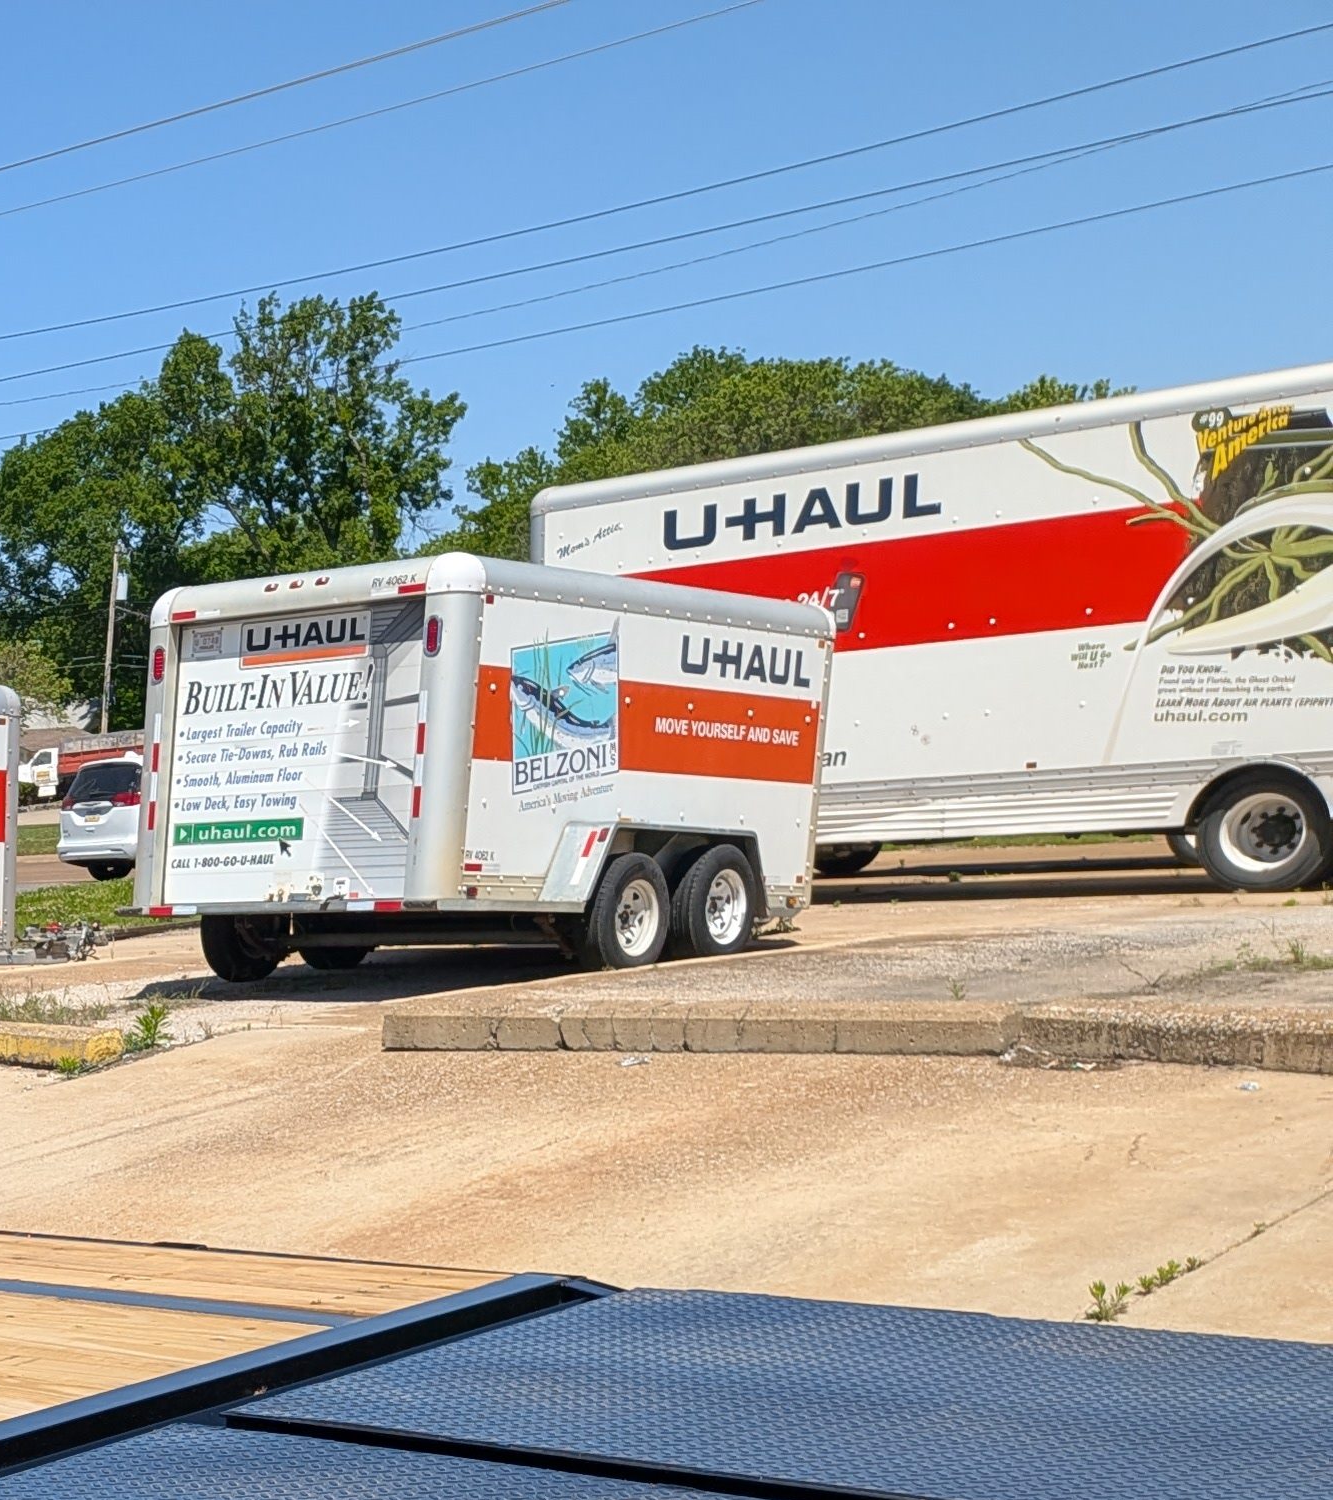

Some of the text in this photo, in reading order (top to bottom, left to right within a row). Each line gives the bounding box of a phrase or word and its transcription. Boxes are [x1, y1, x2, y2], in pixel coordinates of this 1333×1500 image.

[1196, 411, 1257, 454] Venture
[1211, 413, 1289, 481] America
[663, 472, 942, 551] U-HAUL
[556, 536, 590, 560] Mom's
[371, 573, 418, 588] RV 4062 K
[246, 616, 365, 652] U-HAUL
[681, 634, 811, 689] U-HAUL
[182, 663, 375, 715] BUILT-IN VALUE!
[1153, 710, 1248, 722] uhaul.com
[186, 720, 303, 743] Largest Trailer Capacity
[655, 717, 800, 747] MOVE YOURSELF AND SAVE
[185, 740, 328, 765] Secure Tie-Downs, Rub Rails
[514, 743, 607, 786] BELZONI
[183, 769, 303, 788] Smooth, Aluminum Floor
[181, 793, 298, 812] Low Deck, Easy Towing
[553, 789, 579, 805] Moving
[198, 822, 296, 840] uhaul.com
[171, 857, 190, 869] CALL
